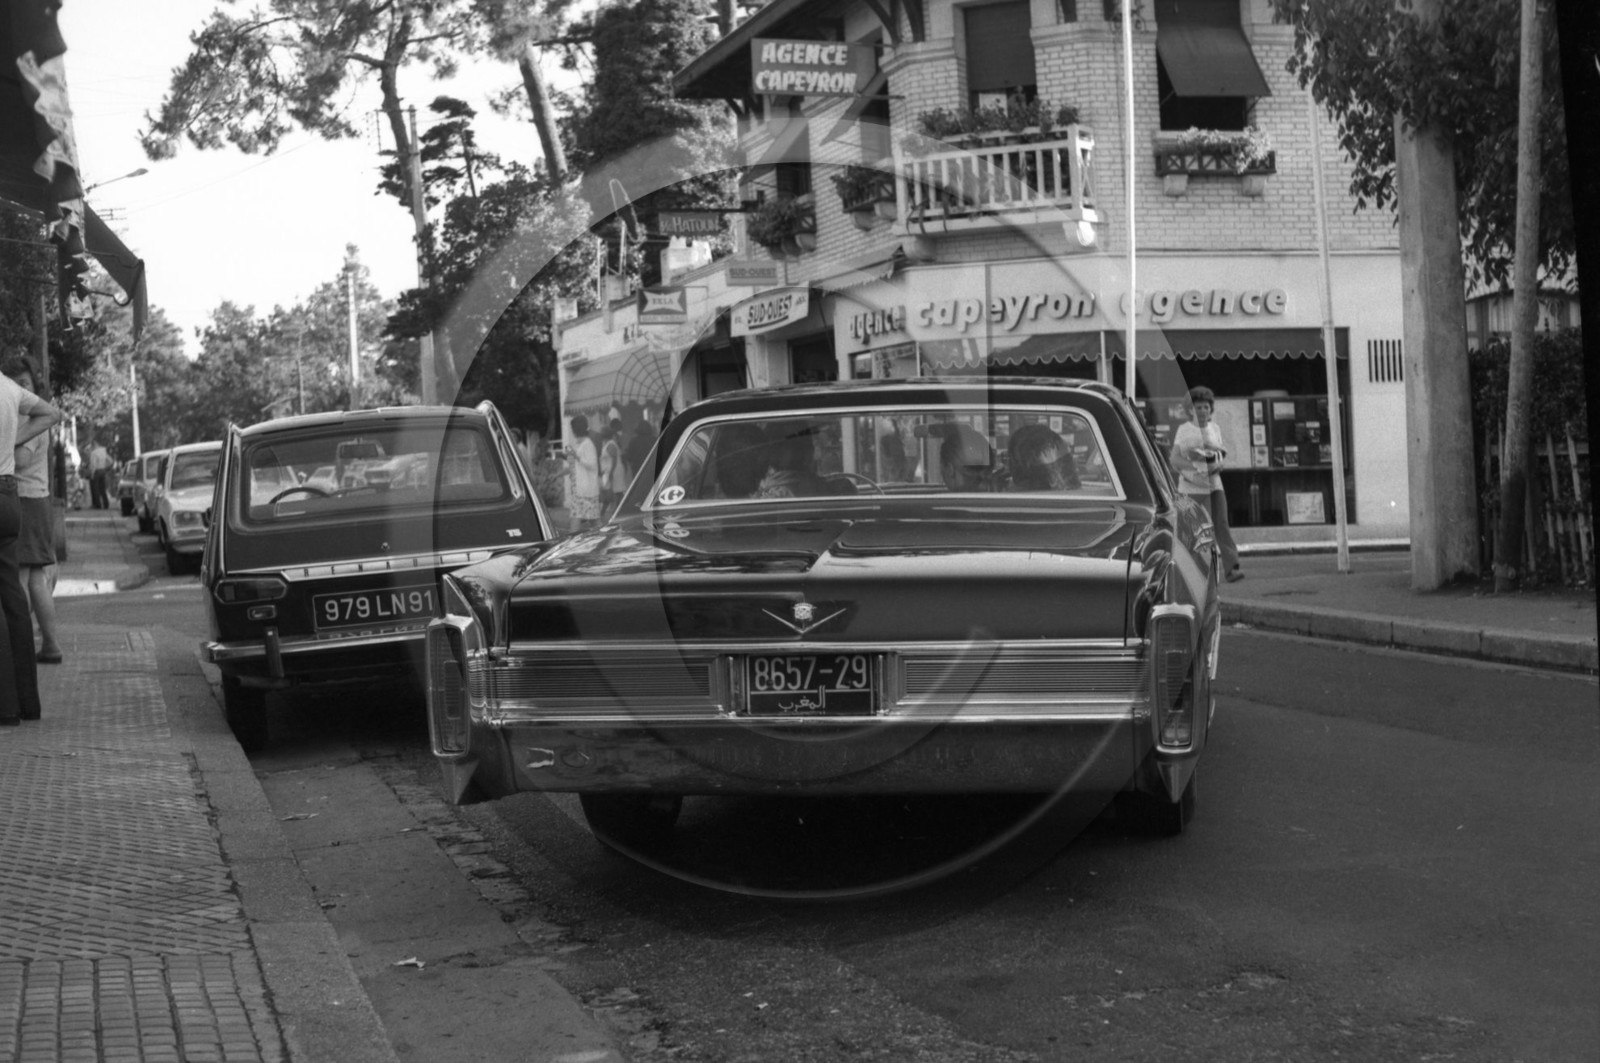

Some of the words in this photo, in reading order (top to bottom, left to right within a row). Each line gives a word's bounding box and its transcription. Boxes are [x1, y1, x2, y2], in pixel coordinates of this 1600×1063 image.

[761, 42, 848, 66] AGENCE
[755, 70, 857, 93] CAPEYRON
[747, 294, 792, 325] SUD-OUEST
[915, 293, 1096, 334] capeyron
[1120, 288, 1288, 325] agence
[850, 304, 907, 345] agence
[303, 552, 471, 578] RENAULT
[324, 596, 371, 622] 979
[754, 655, 867, 691] 8657-29
[778, 685, 826, 712] المغرب
